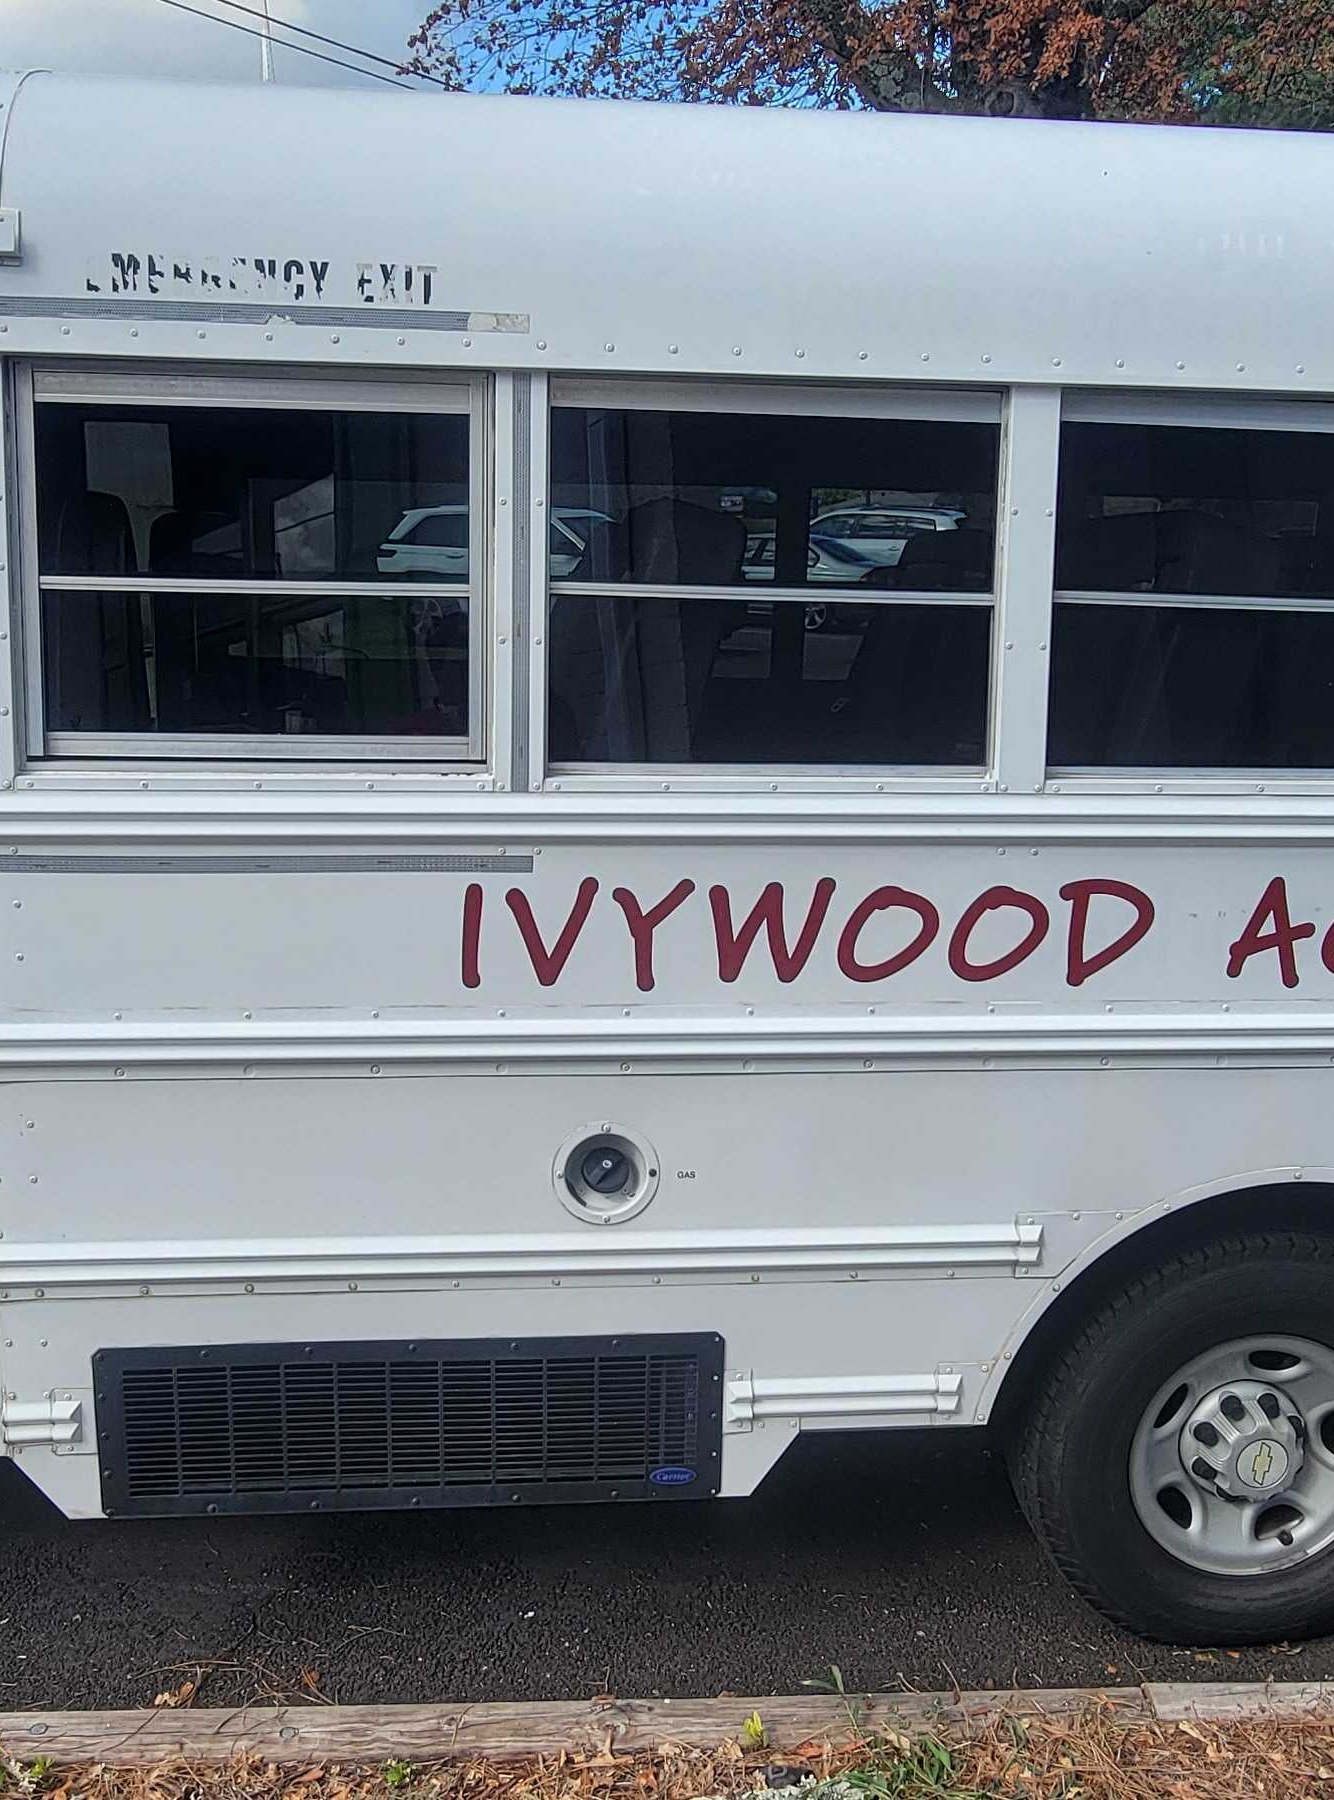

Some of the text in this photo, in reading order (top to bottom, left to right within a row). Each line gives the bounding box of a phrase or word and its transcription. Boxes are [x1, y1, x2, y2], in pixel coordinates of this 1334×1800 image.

[85, 252, 438, 305] MENCY EXIT
[462, 876, 1155, 991] IVYWOOD
[676, 1171, 696, 1180] GAS
